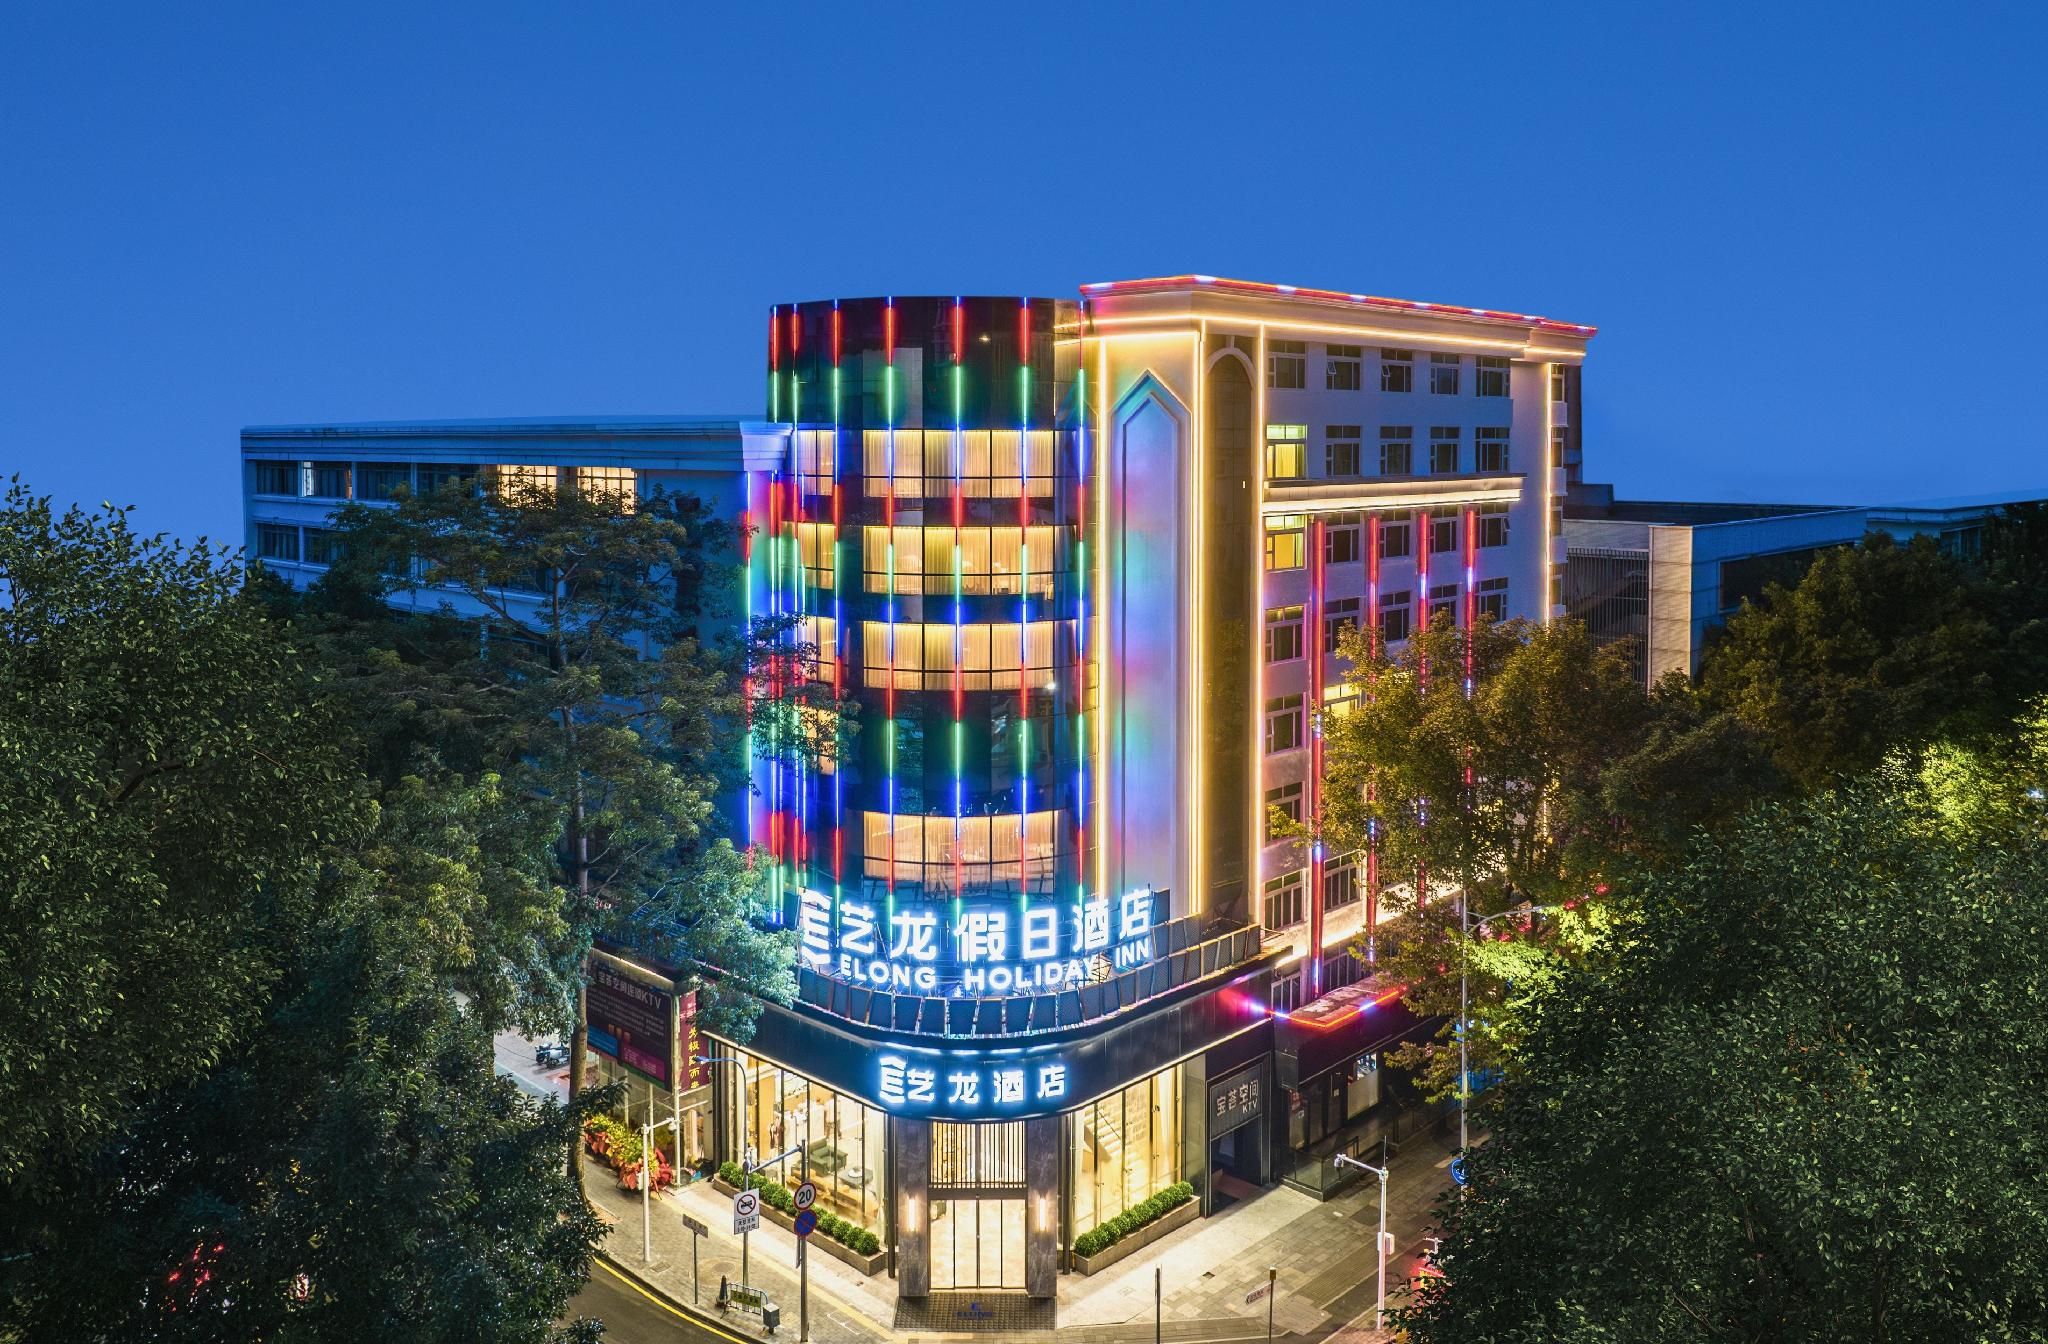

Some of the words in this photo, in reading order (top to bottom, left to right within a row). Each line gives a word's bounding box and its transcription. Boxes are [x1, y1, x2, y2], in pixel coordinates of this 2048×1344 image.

[840, 889, 1150, 961] 艺龙假日酒店
[840, 953, 936, 989] ELONG
[964, 953, 1101, 991] HOLIDAY
[1115, 937, 1149, 968] INN
[906, 1065, 1066, 1104] 艺龙酒店
[1242, 1097, 1258, 1114] KTV
[798, 1189, 812, 1205] 20
